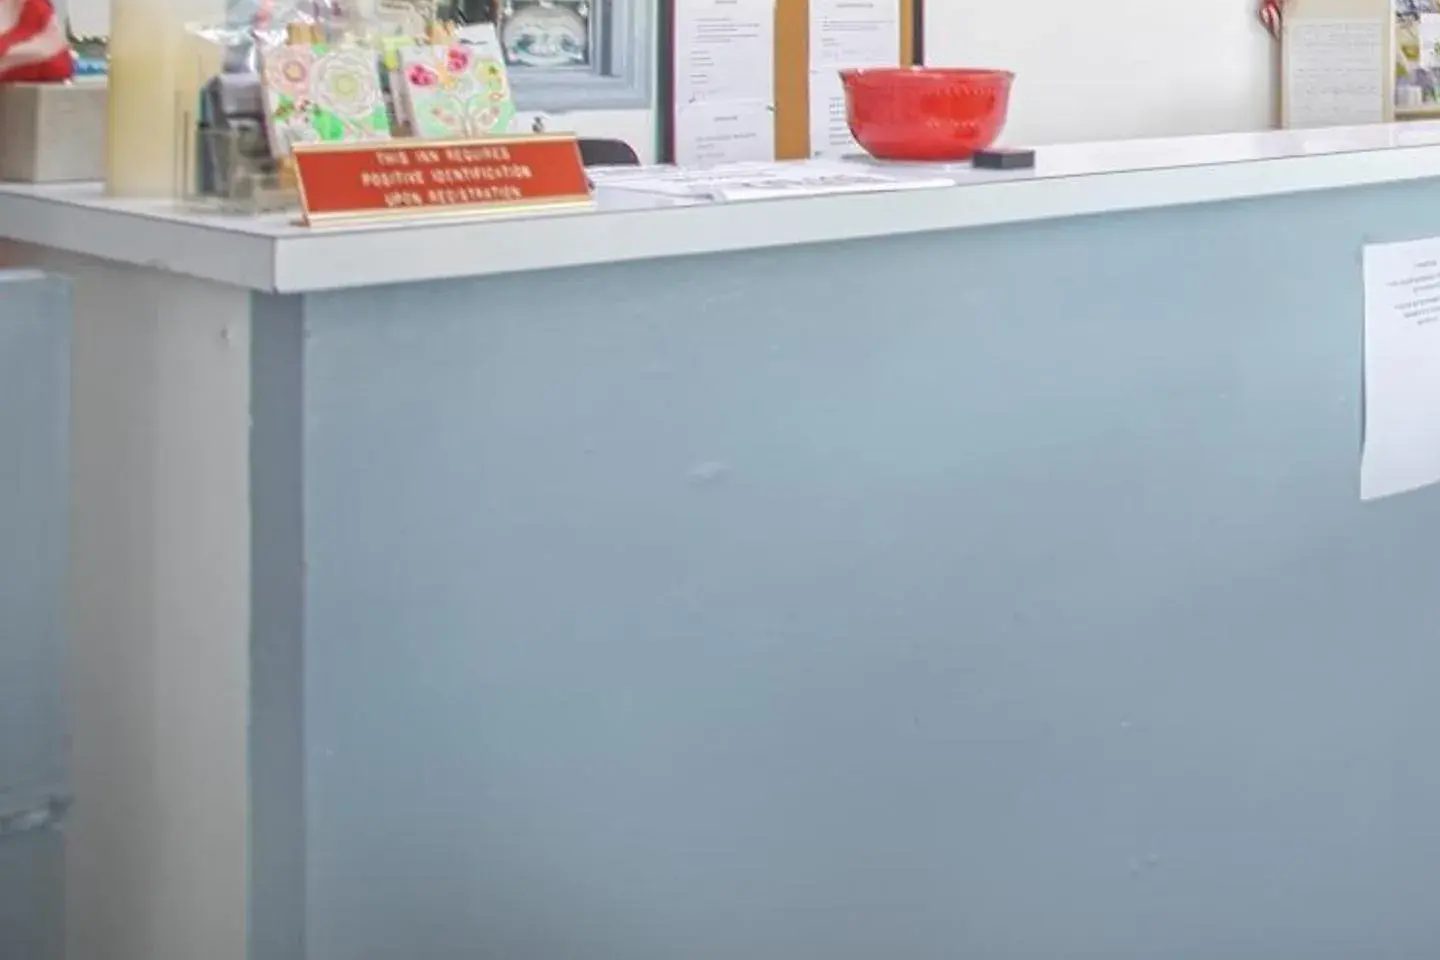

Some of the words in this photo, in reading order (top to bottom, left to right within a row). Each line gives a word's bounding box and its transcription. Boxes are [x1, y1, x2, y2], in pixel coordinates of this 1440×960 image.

[375, 150, 409, 166] THIS
[444, 145, 511, 163] REQUIRES
[360, 169, 425, 187] POSITIVE
[430, 163, 533, 184] IDENTIFICATION
[427, 185, 522, 205] REGISTRATION
